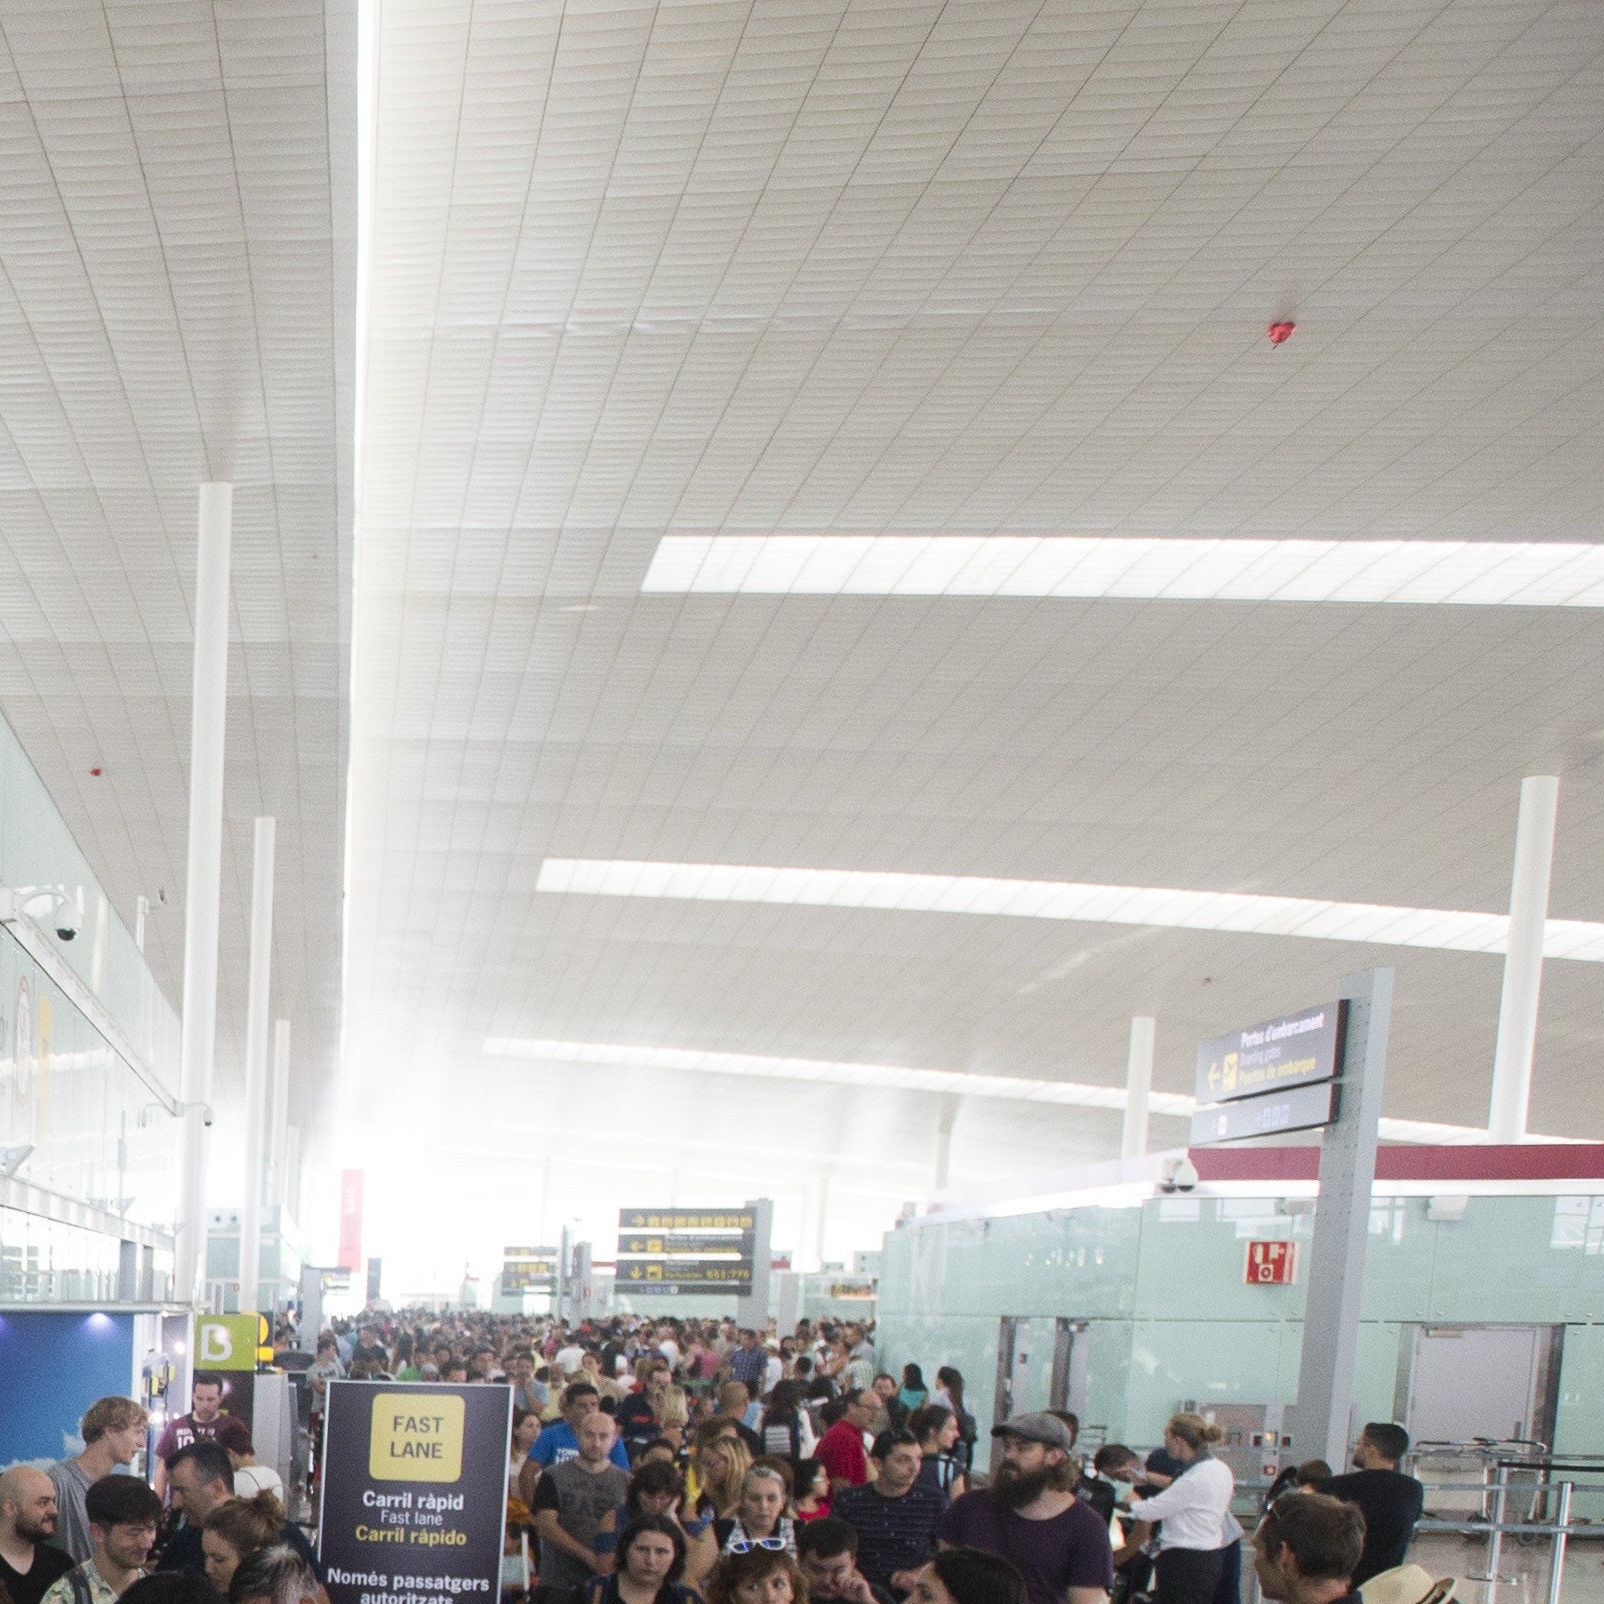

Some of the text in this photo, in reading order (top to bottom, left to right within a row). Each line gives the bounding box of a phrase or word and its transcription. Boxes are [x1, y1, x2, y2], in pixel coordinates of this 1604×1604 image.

[393, 1416, 444, 1434] FAST
[390, 1440, 444, 1459] LANE
[362, 1491, 465, 1513] Carril ràpid
[380, 1510, 444, 1526] Fast lane
[355, 1525, 467, 1549] Carril rápido
[327, 1568, 490, 1594] Només passatgers
